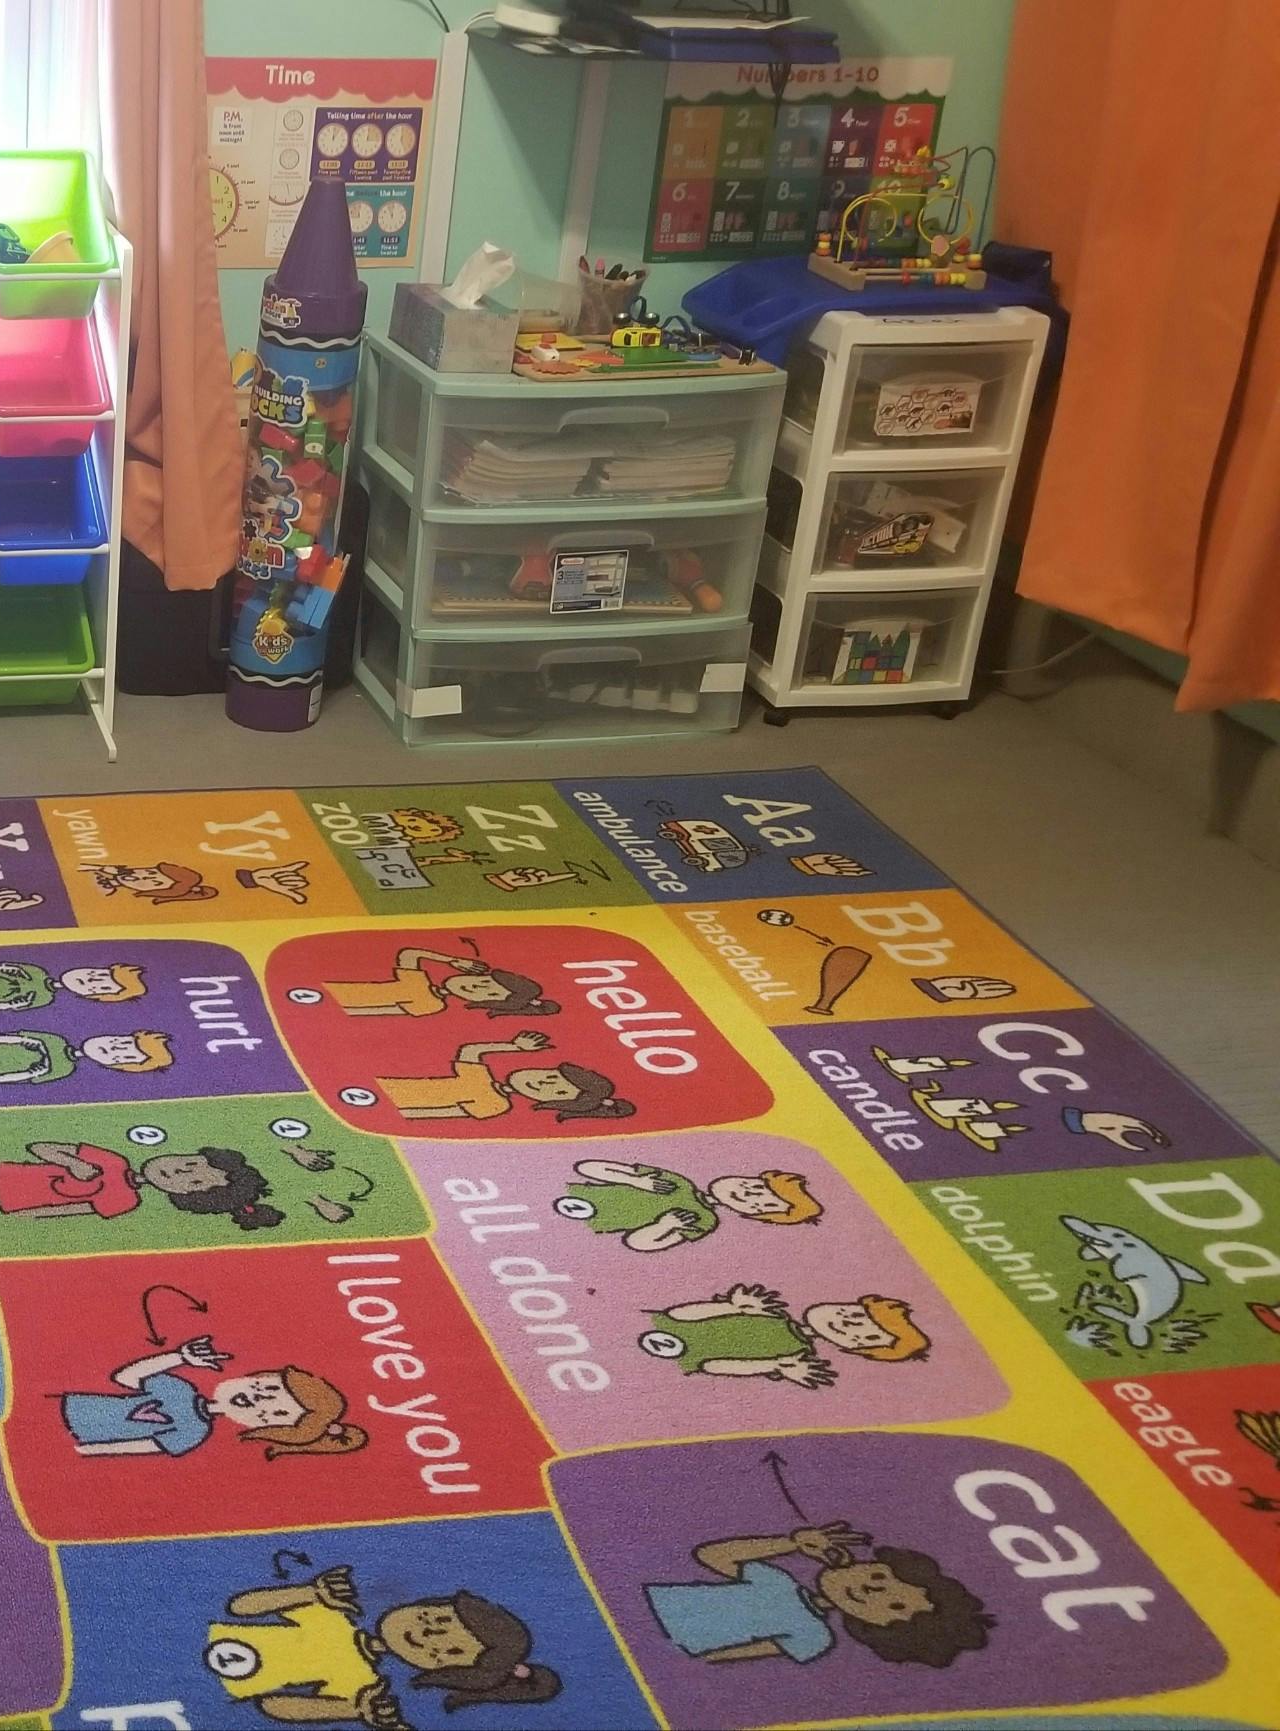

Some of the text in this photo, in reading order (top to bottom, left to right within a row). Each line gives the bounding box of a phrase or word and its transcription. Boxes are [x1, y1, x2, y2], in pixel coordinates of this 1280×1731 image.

[265, 65, 316, 85] Time
[736, 65, 880, 82] Nuers 1-10
[327, 112, 349, 120] Telling
[736, 109, 750, 127] 2
[787, 108, 800, 126] 3
[841, 108, 855, 128] 4
[894, 107, 908, 127] 5
[672, 183, 689, 201] 6
[725, 181, 741, 201] 7
[777, 182, 791, 201] 8
[54, 807, 109, 860] yawn
[204, 811, 282, 863] Yy
[311, 801, 371, 847] zoo
[465, 803, 560, 854] Zz
[723, 793, 814, 848] Aa
[573, 789, 688, 895] ambulance
[840, 900, 955, 967] Bb
[683, 909, 800, 1002] baseball
[295, 991, 317, 1001] 1
[179, 976, 263, 1053] hurt
[562, 959, 698, 1075] hello
[977, 1022, 1090, 1095] Cc
[348, 1089, 370, 1104] 2
[808, 1048, 926, 1154] candle
[138, 1127, 160, 1143] 2
[279, 1121, 302, 1135] 1
[563, 1202, 585, 1216] 1
[930, 1186, 1059, 1302] dolphin
[443, 1177, 611, 1393] all done
[650, 1336, 678, 1354] 2
[327, 1252, 481, 1495] I love you
[1113, 1382, 1233, 1488] eagle
[953, 1469, 1155, 1632] cat
[217, 1652, 246, 1668] 1
